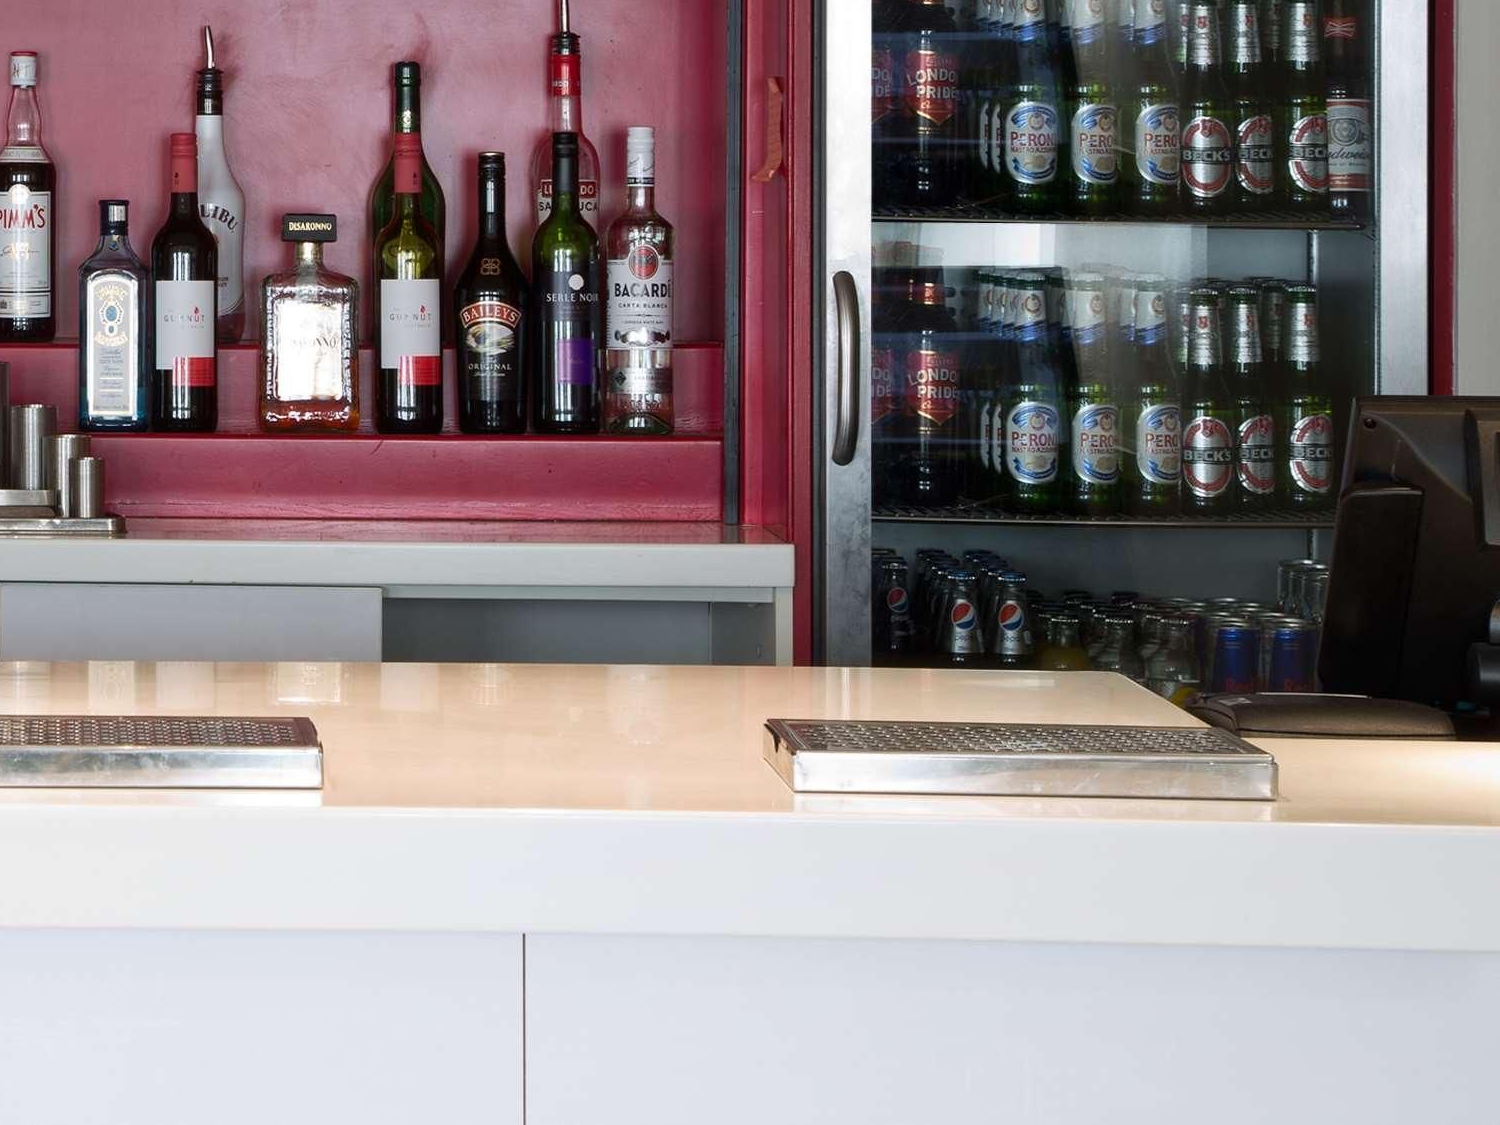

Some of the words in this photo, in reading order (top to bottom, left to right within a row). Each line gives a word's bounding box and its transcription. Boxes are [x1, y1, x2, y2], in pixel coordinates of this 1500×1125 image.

[906, 68, 957, 86] LONDO
[1182, 149, 1231, 161] BECK'S
[289, 222, 332, 231] DISARONNO
[463, 304, 518, 323] BAILEYS
[468, 363, 512, 371] ORIGINAL
[908, 368, 957, 386] LONDO
[1183, 448, 1232, 462] BECK'S
